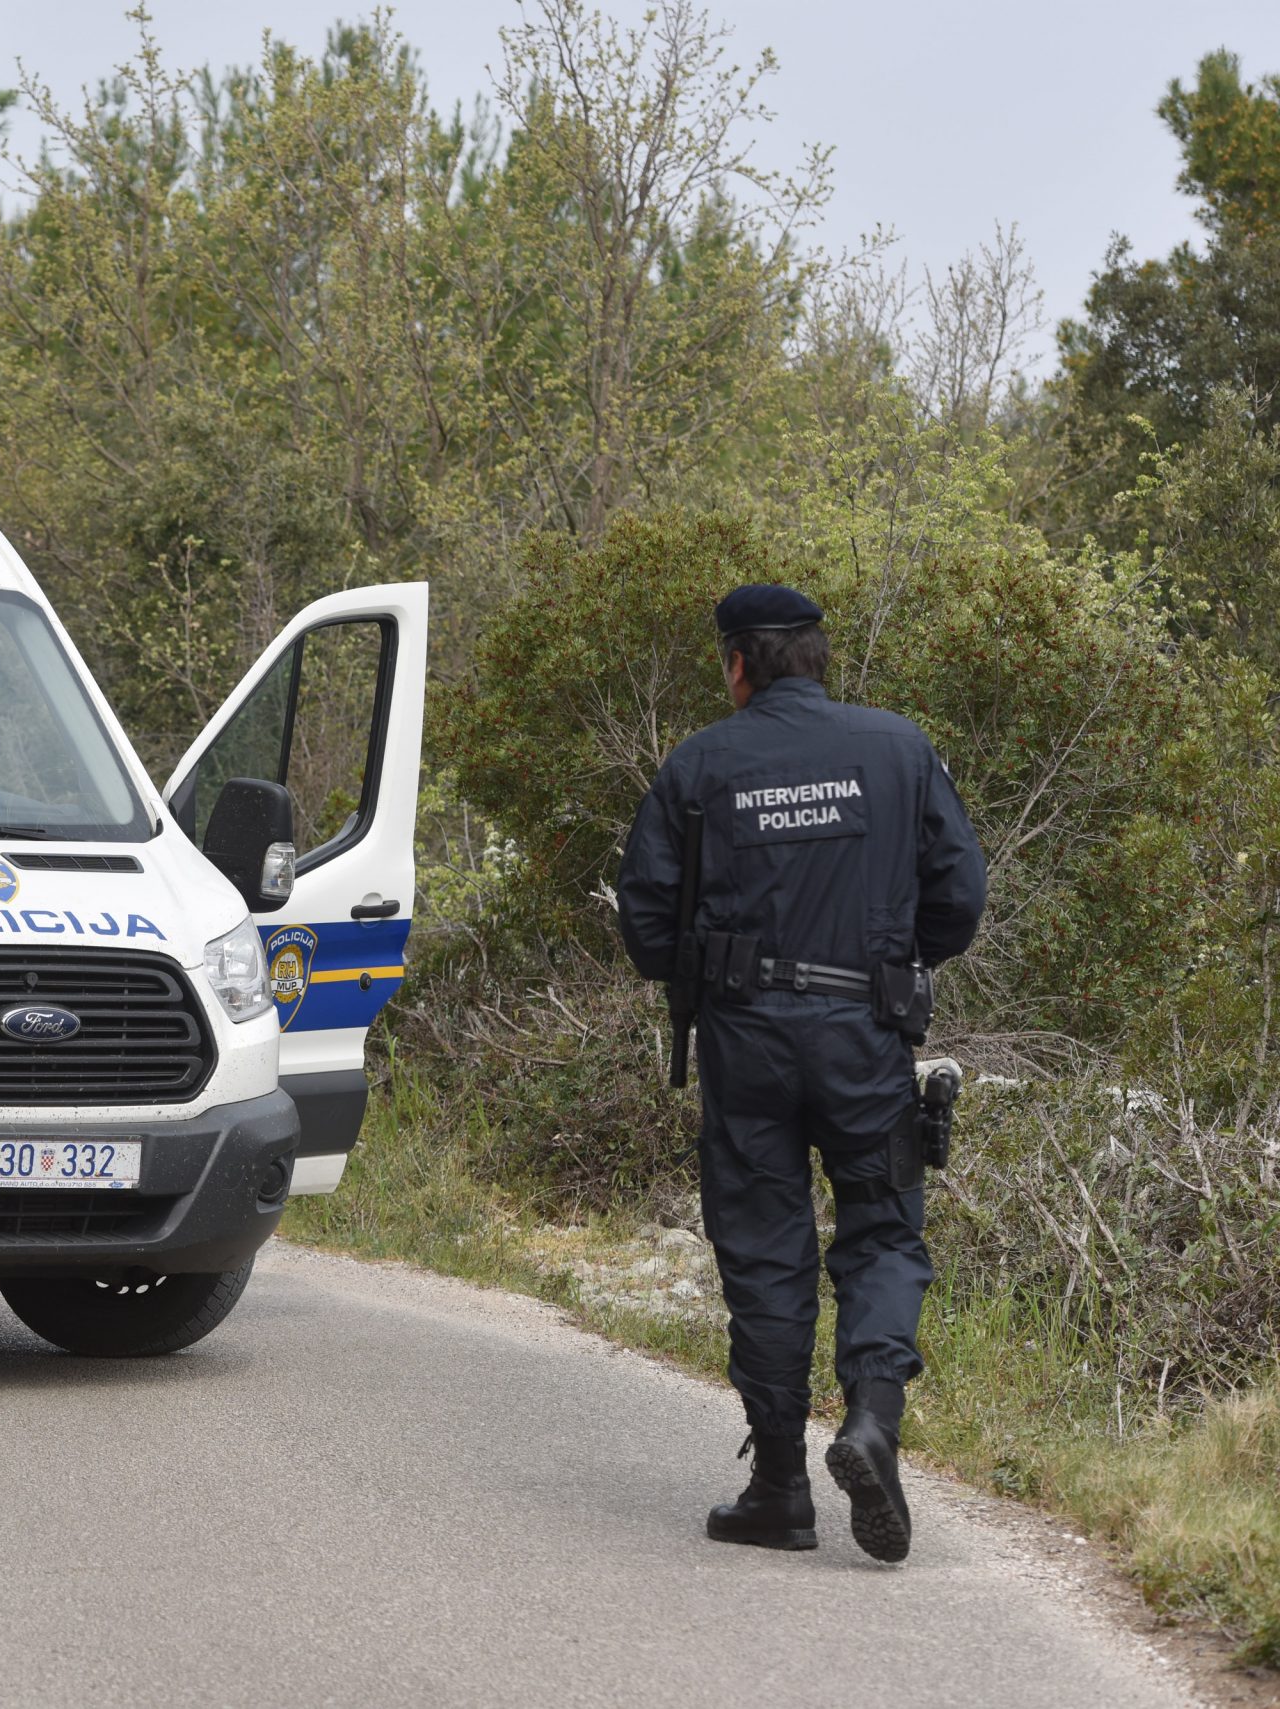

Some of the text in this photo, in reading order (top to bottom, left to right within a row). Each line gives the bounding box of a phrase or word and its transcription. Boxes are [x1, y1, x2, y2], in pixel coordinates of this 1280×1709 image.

[735, 779, 862, 810] INTERVENTNA
[758, 806, 841, 831] POLICIJA
[270, 931, 314, 951] POLICIJA
[278, 961, 296, 979] RH
[276, 981, 297, 991] MUP
[21, 1012, 64, 1034] Ford
[61, 1144, 116, 1177] 332
